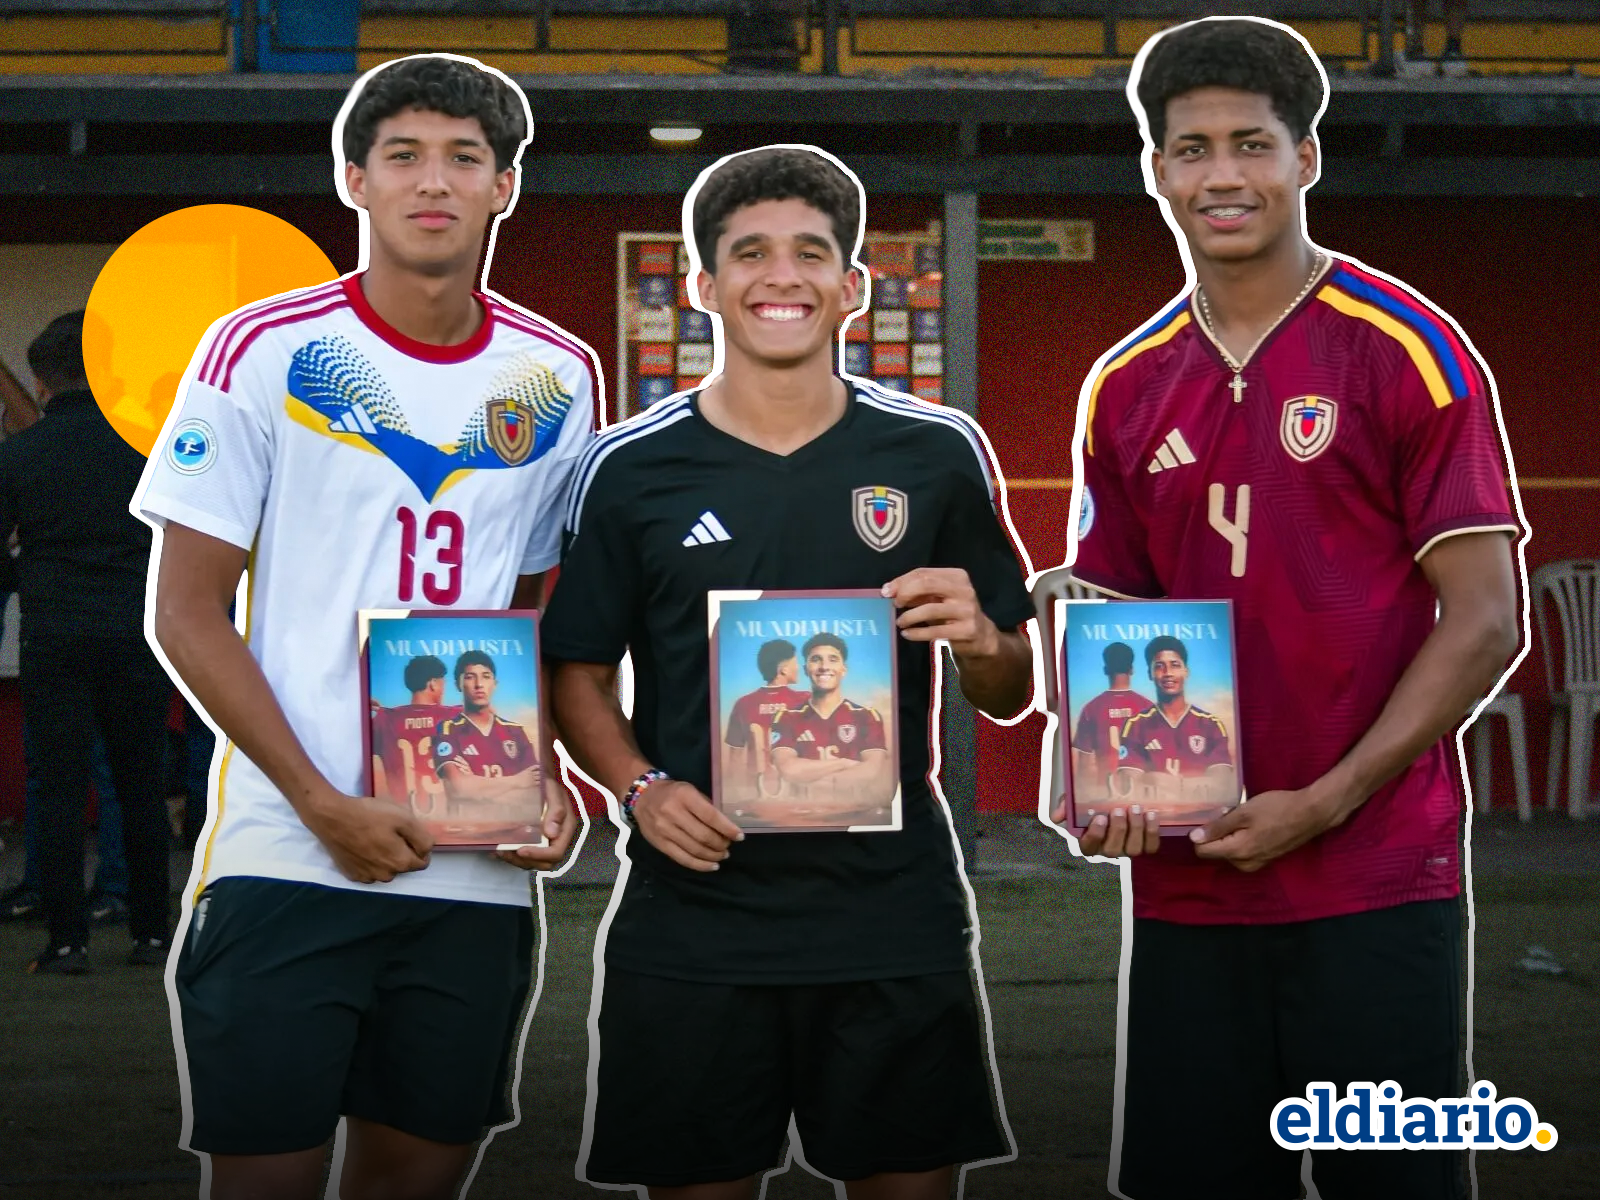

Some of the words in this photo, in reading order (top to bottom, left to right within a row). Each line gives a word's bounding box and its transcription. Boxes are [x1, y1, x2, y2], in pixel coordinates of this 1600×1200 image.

[1208, 483, 1251, 577] 4
[397, 506, 465, 606] 13
[736, 619, 880, 638] MUNDIALISTA
[1082, 623, 1219, 641] MUNDIALISTA
[385, 639, 524, 657] MUNDIALISTA
